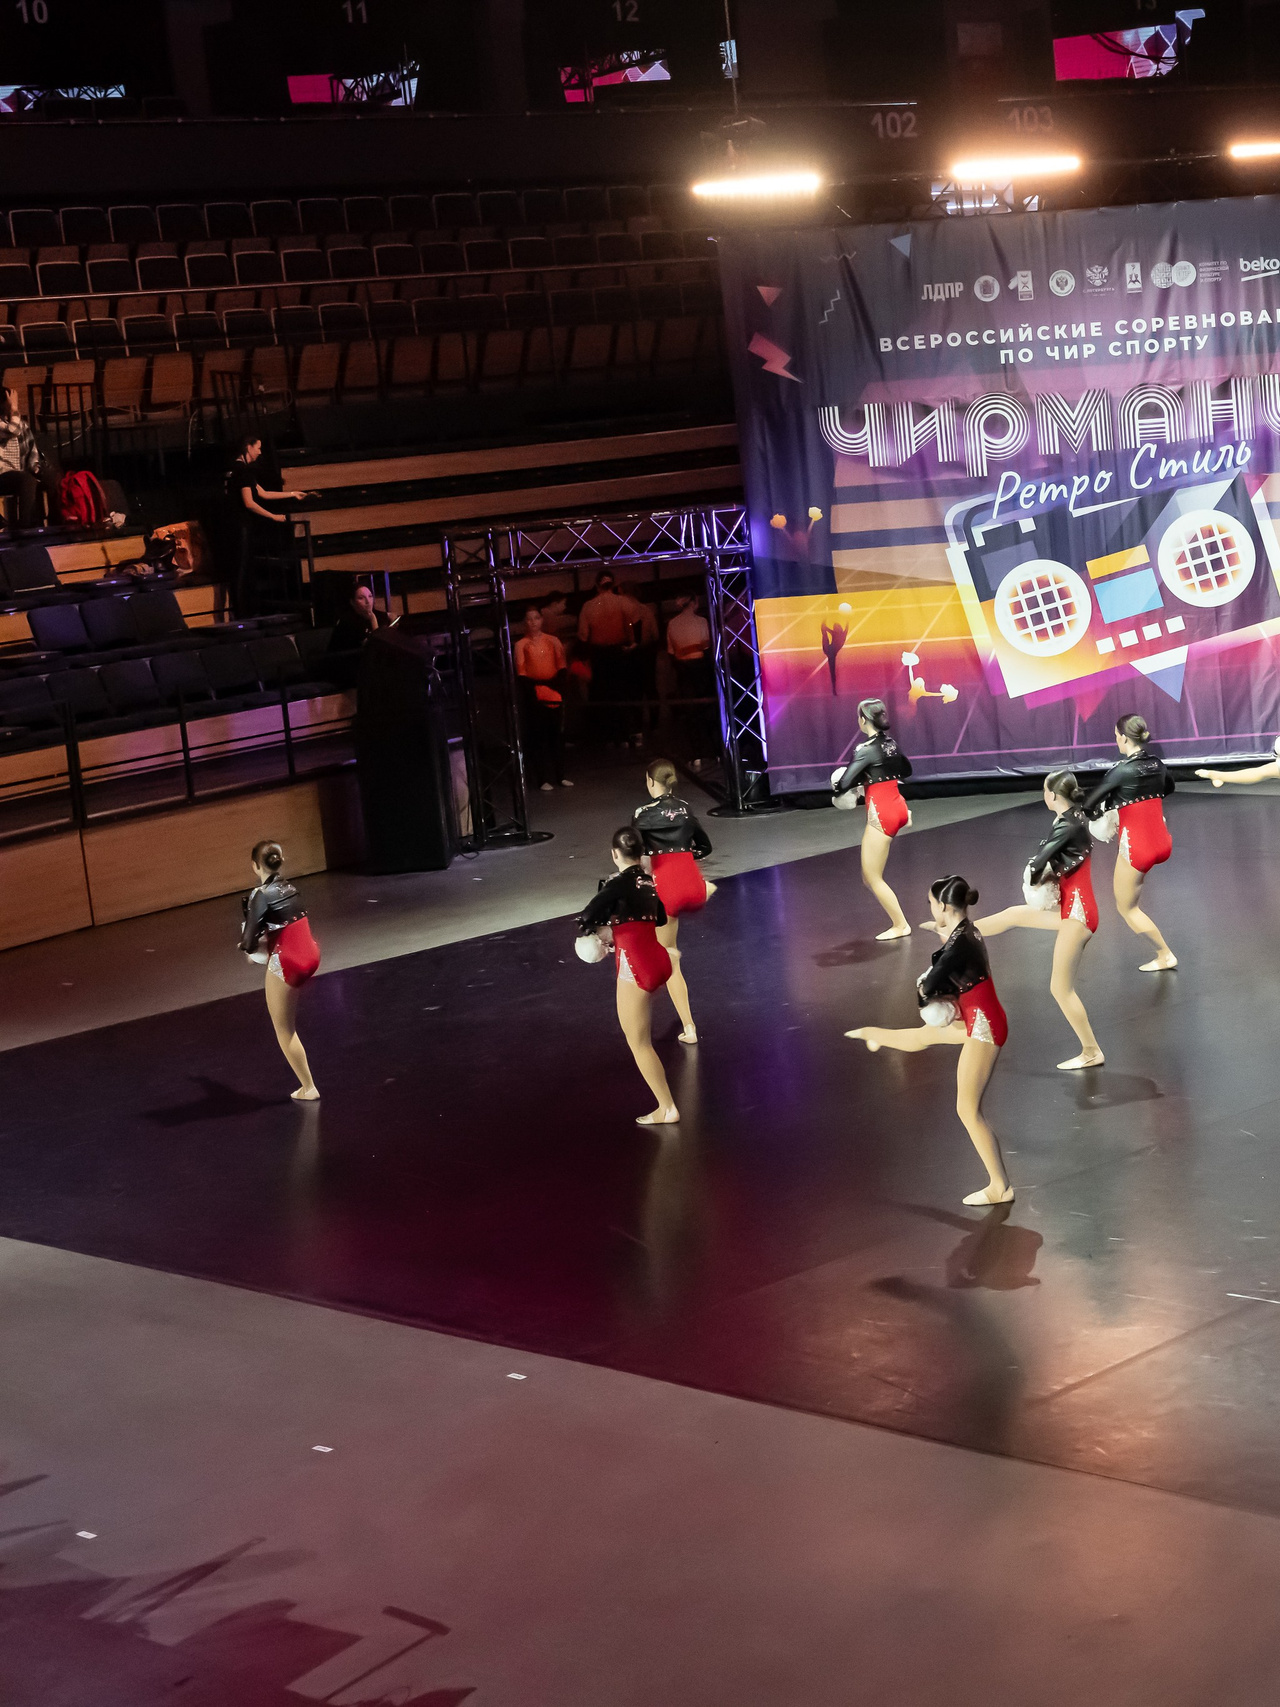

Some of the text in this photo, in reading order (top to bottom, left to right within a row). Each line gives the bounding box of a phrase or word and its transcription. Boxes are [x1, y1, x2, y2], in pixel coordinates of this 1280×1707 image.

[16, 0, 48, 23] 10
[342, 0, 367, 23] 11
[612, 0, 639, 21] 12
[871, 111, 917, 138] 102
[1008, 105, 1054, 133] 103
[1239, 256, 1280, 272] beko
[921, 281, 964, 301] ЛДПР
[879, 322, 1103, 352] ВСЕРОССИЙСКИЕ
[1000, 335, 1209, 364] ПО ЧИР СПОРТУ
[992, 440, 1252, 519] Ретро Стиль
